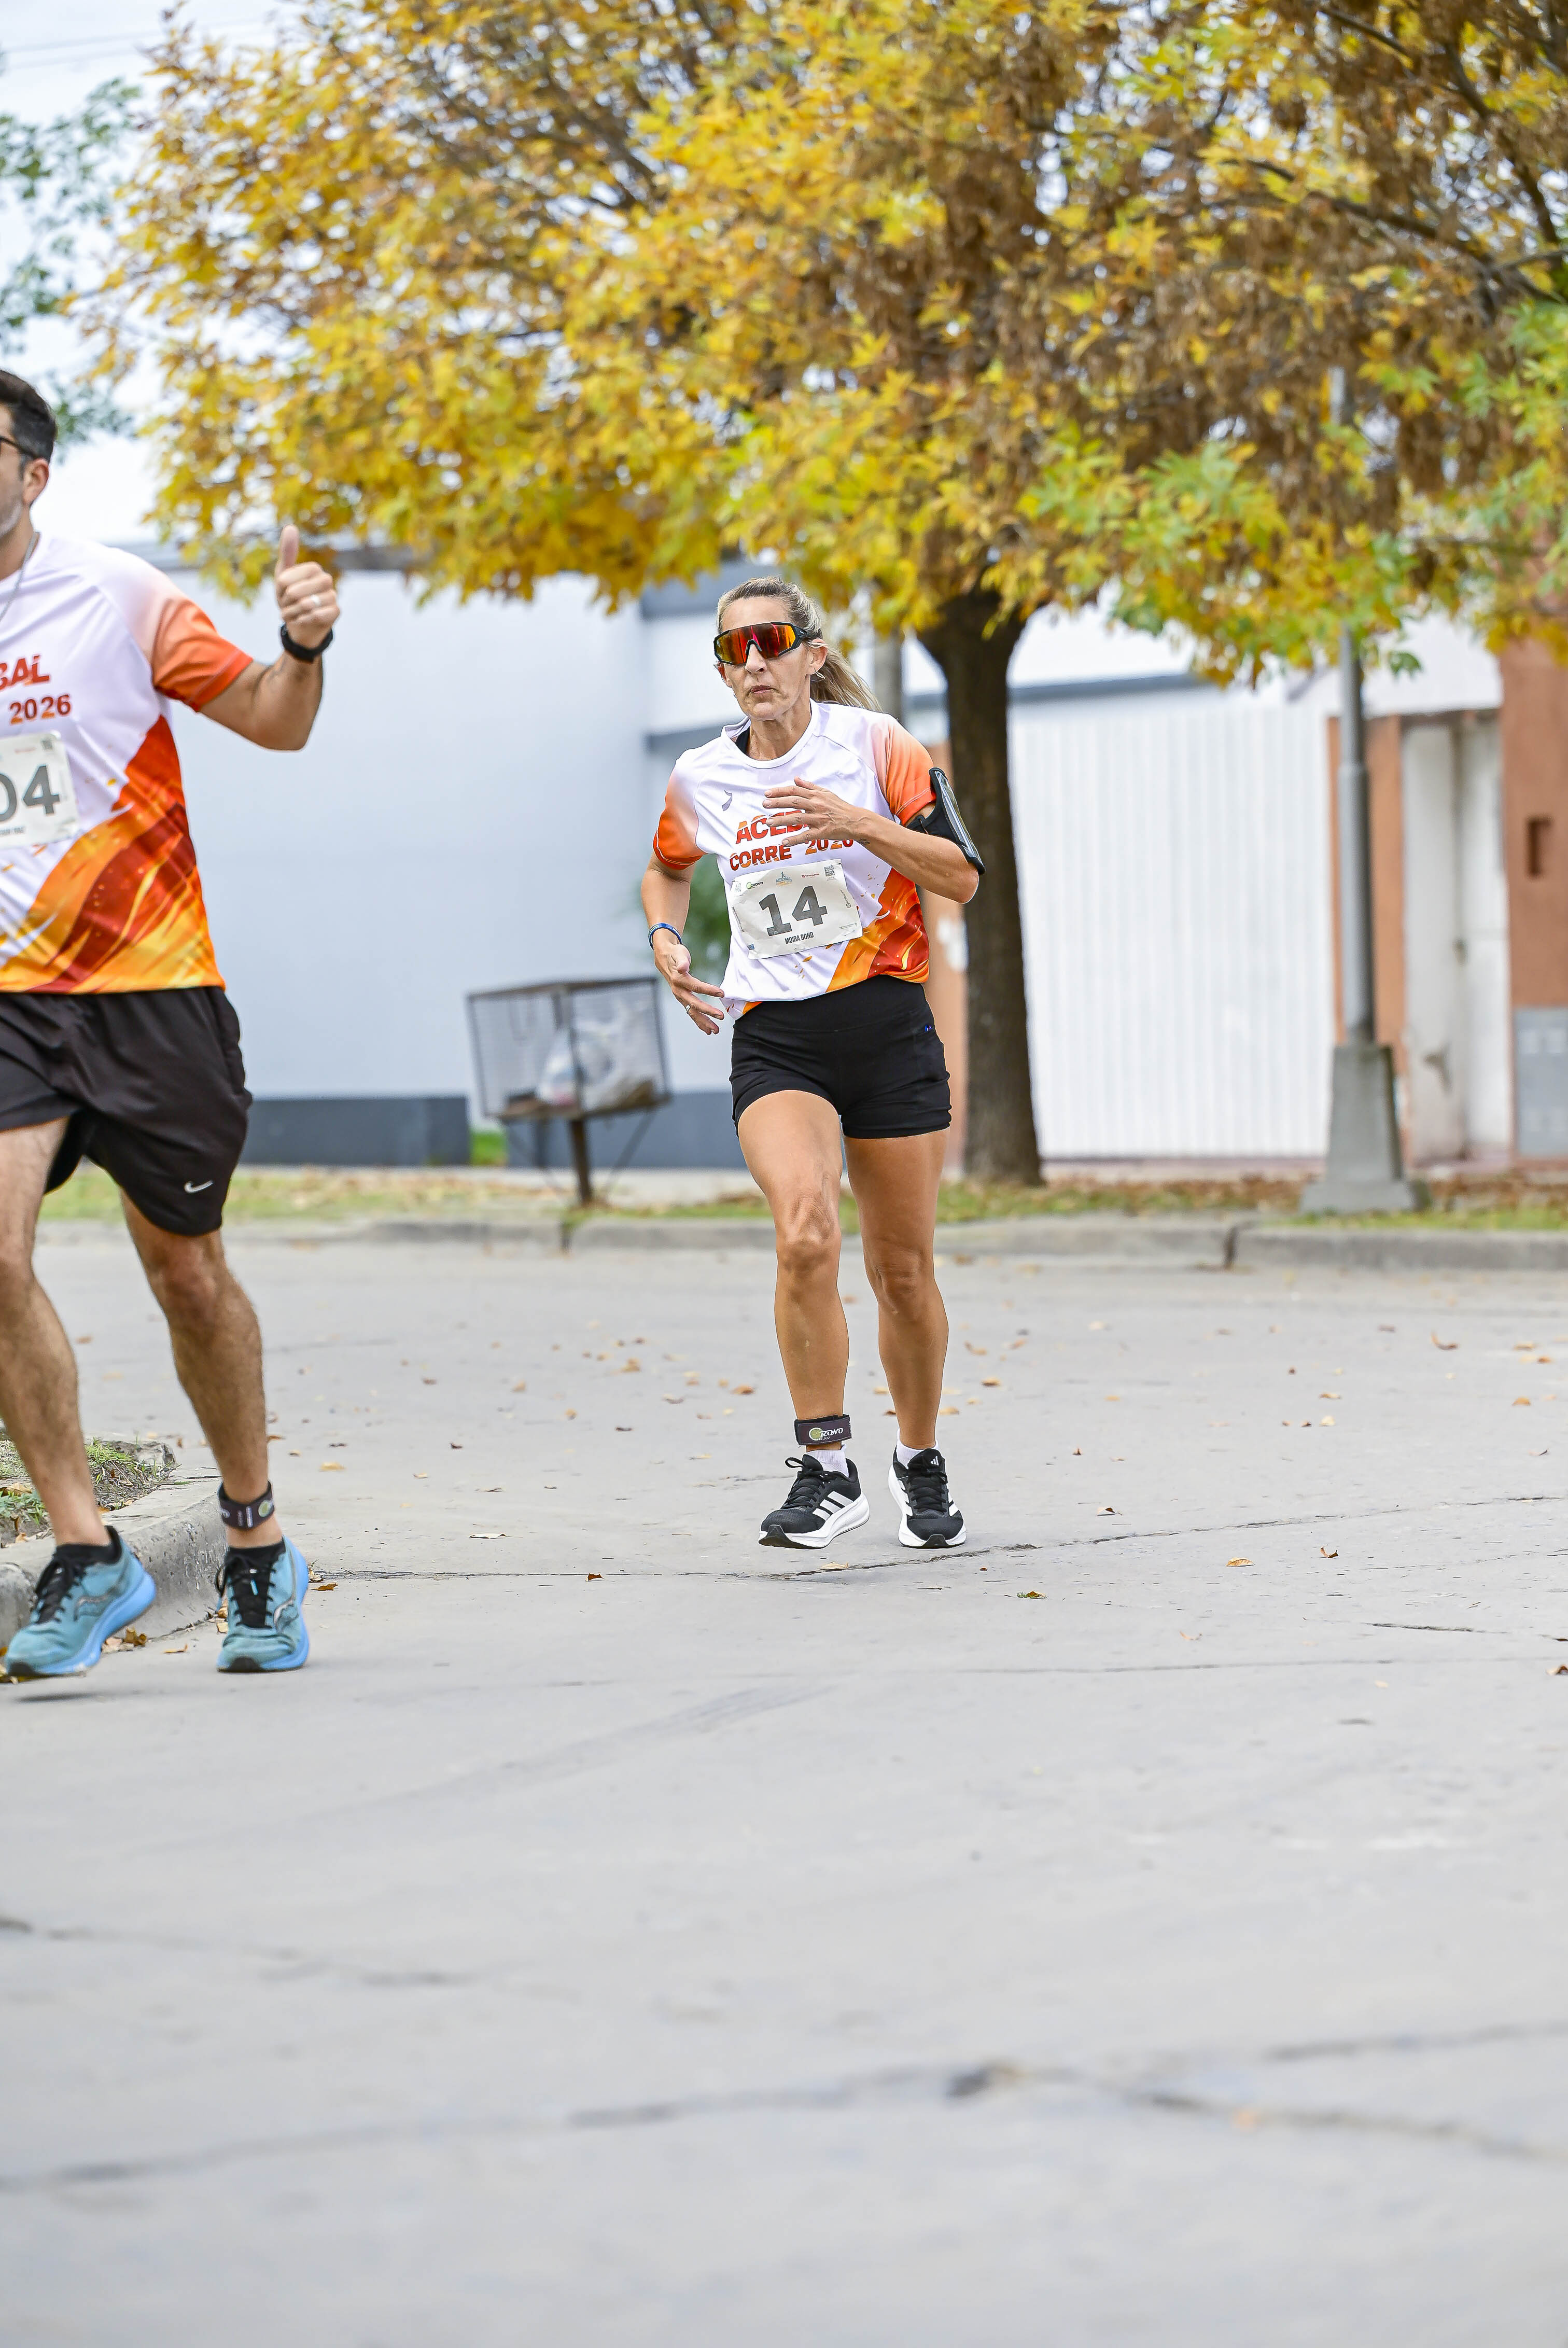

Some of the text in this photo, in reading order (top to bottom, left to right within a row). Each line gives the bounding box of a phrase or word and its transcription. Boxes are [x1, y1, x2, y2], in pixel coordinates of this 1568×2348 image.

[10, 694, 72, 725] 2026
[736, 810, 809, 844] ACE
[730, 844, 792, 871] CORRE
[759, 886, 828, 937] 14
[785, 932, 814, 944] MOIRA BOND
